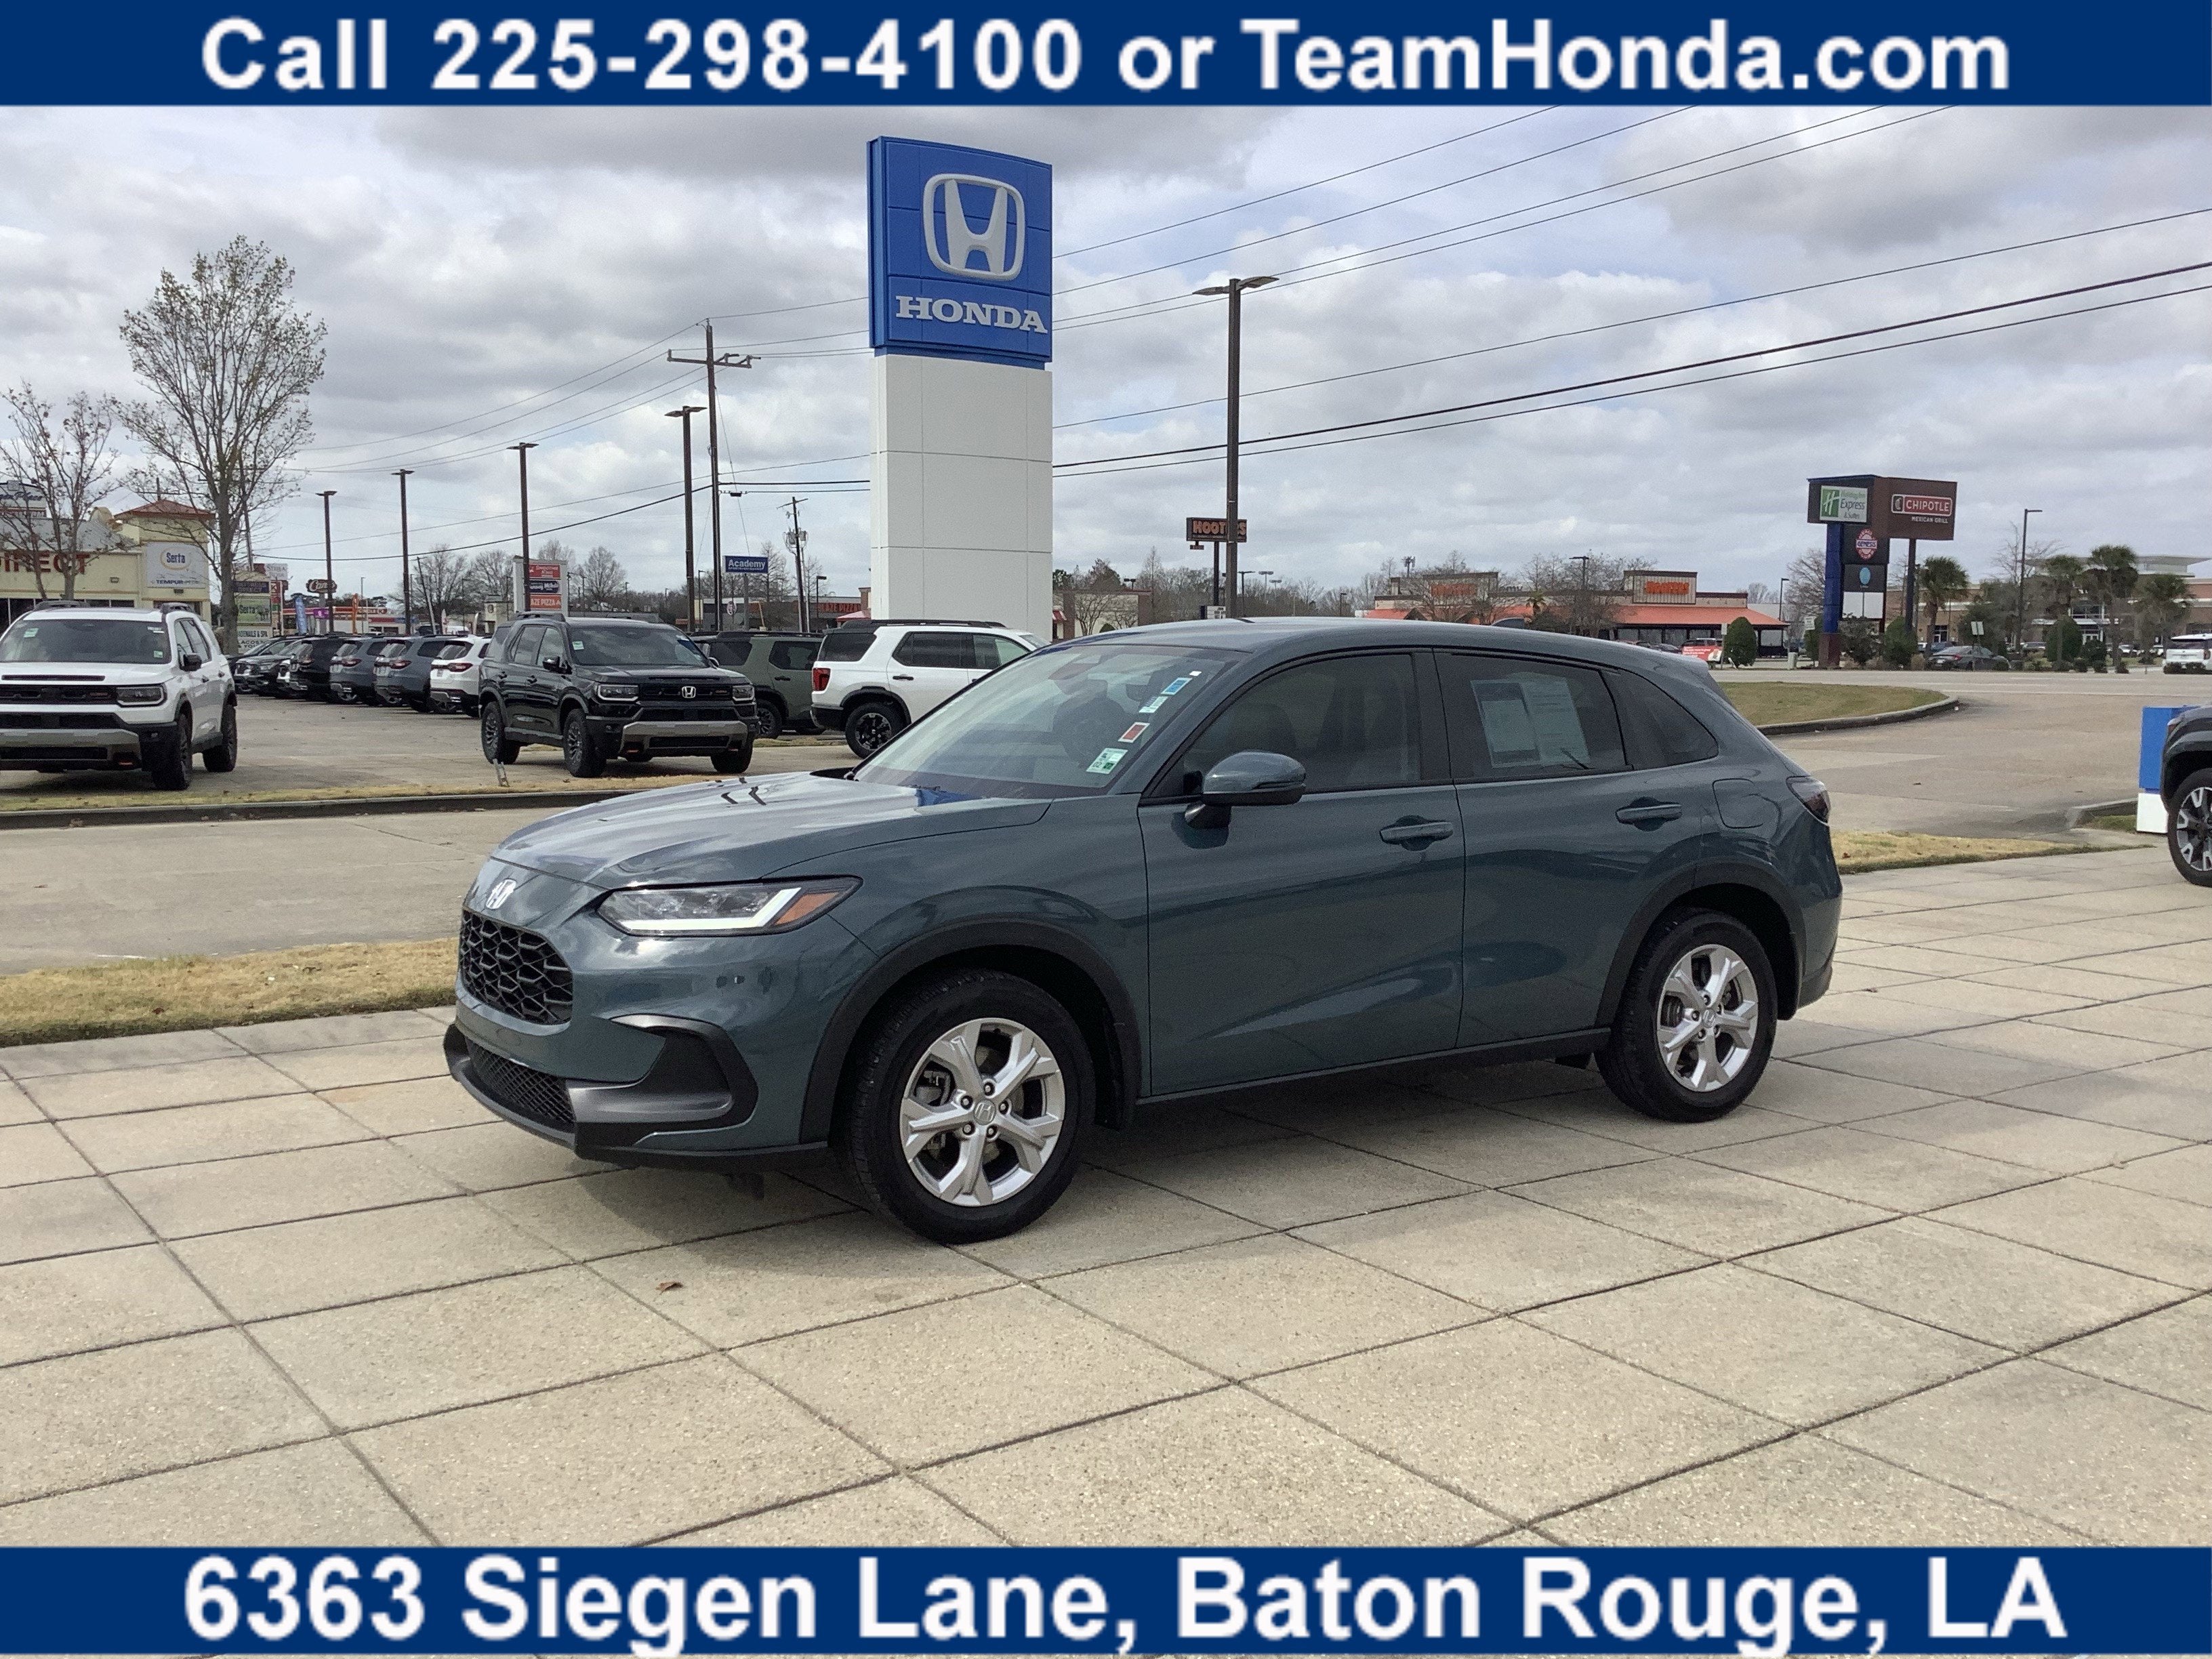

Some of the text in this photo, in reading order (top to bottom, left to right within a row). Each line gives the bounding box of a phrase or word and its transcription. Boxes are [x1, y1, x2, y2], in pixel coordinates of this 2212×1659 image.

[896, 295, 1048, 334] HONDA
[1840, 498, 1866, 511] Express
[1906, 499, 1950, 512] CHIPOTLE
[1193, 520, 1246, 535] HOOTS
[0, 551, 90, 575] IRECT
[166, 552, 186, 564] Serta
[728, 559, 766, 570] Academy
